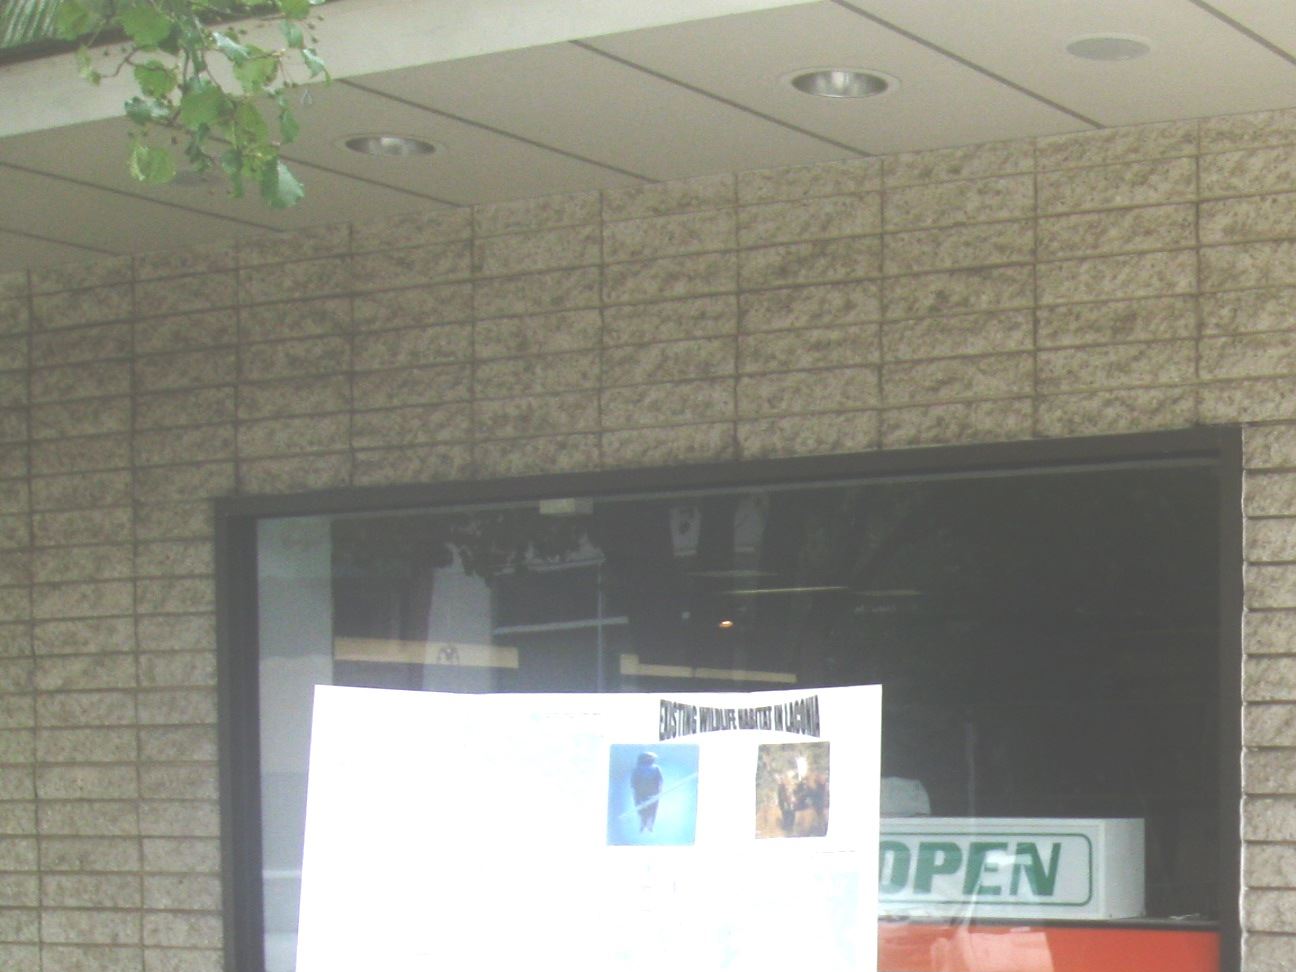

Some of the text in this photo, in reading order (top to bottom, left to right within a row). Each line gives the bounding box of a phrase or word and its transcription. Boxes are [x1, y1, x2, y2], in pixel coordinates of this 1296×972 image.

[659, 694, 820, 742] EXISTING WILDLIFE HABITAT IN LACONIA
[879, 840, 1062, 896] OPEN
